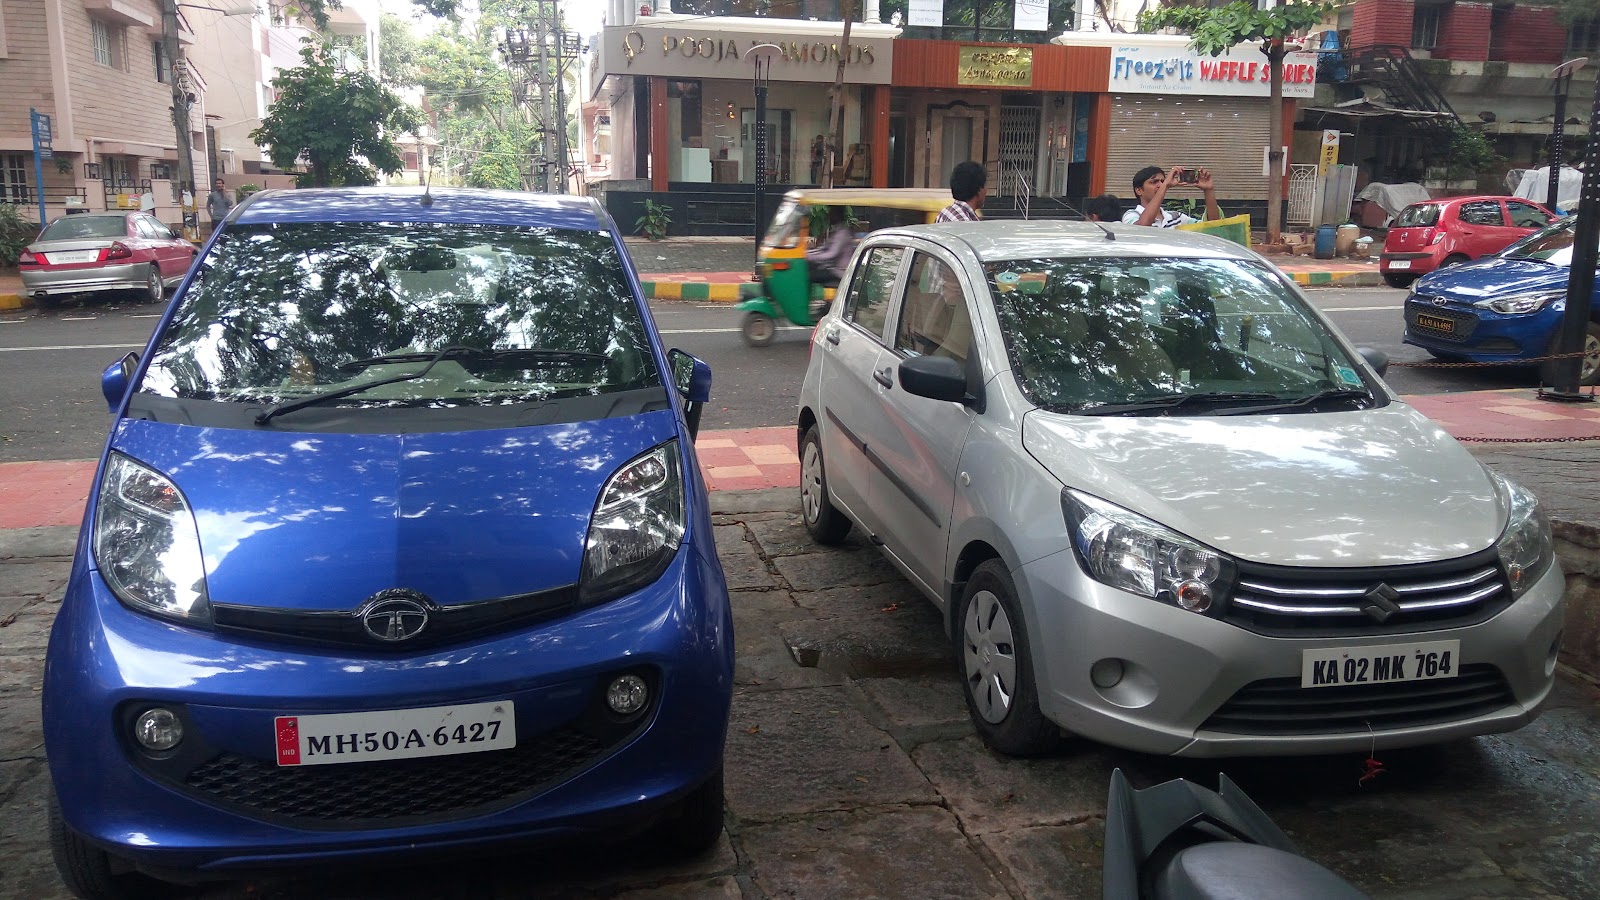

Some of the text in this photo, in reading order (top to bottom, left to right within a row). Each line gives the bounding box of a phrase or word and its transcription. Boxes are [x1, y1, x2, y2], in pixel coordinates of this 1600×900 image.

[662, 35, 875, 65] POOJA AMONDS
[1199, 60, 1258, 81] WAFFLE
[1313, 650, 1451, 685] KA 02 MK 764
[282, 748, 295, 756] IND
